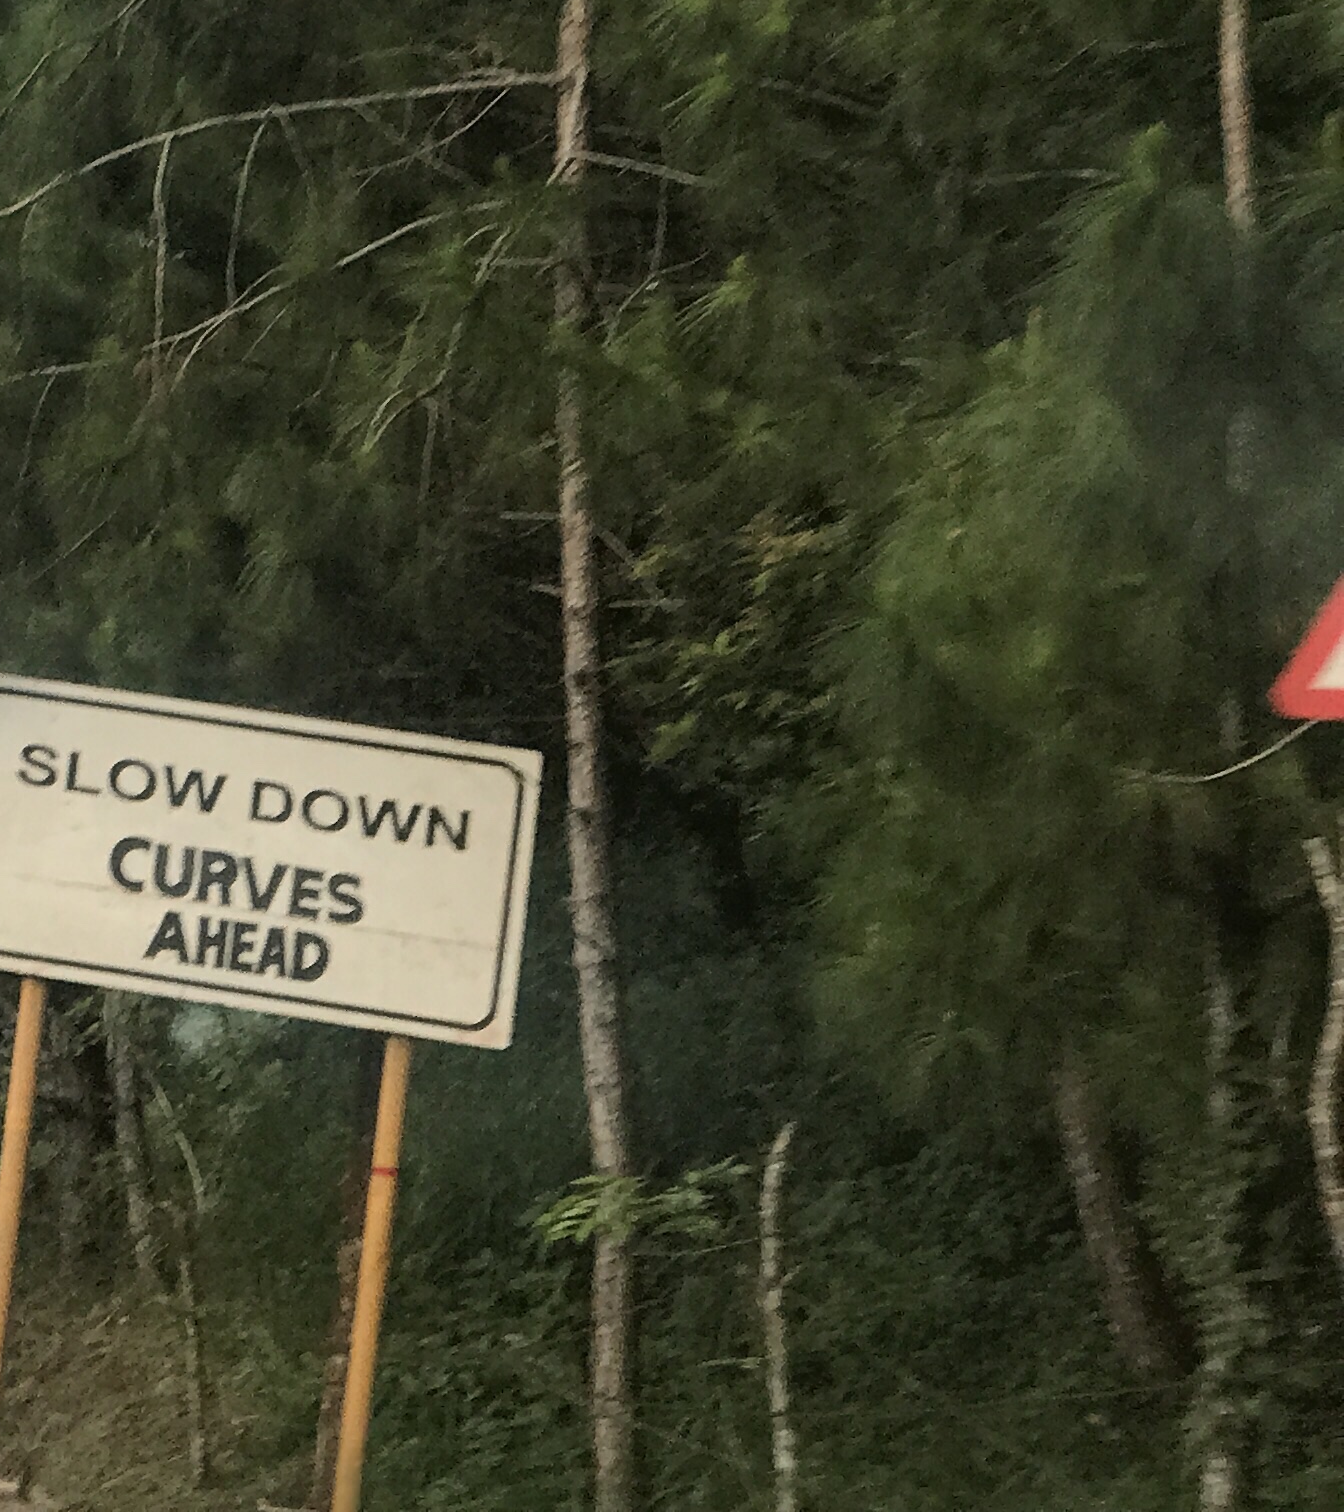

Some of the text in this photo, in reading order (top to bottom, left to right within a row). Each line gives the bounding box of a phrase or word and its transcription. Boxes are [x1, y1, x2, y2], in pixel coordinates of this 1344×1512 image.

[17, 743, 471, 852] SLOW DOWN
[109, 837, 364, 925] CURVES
[144, 911, 331, 983] AHEAD
